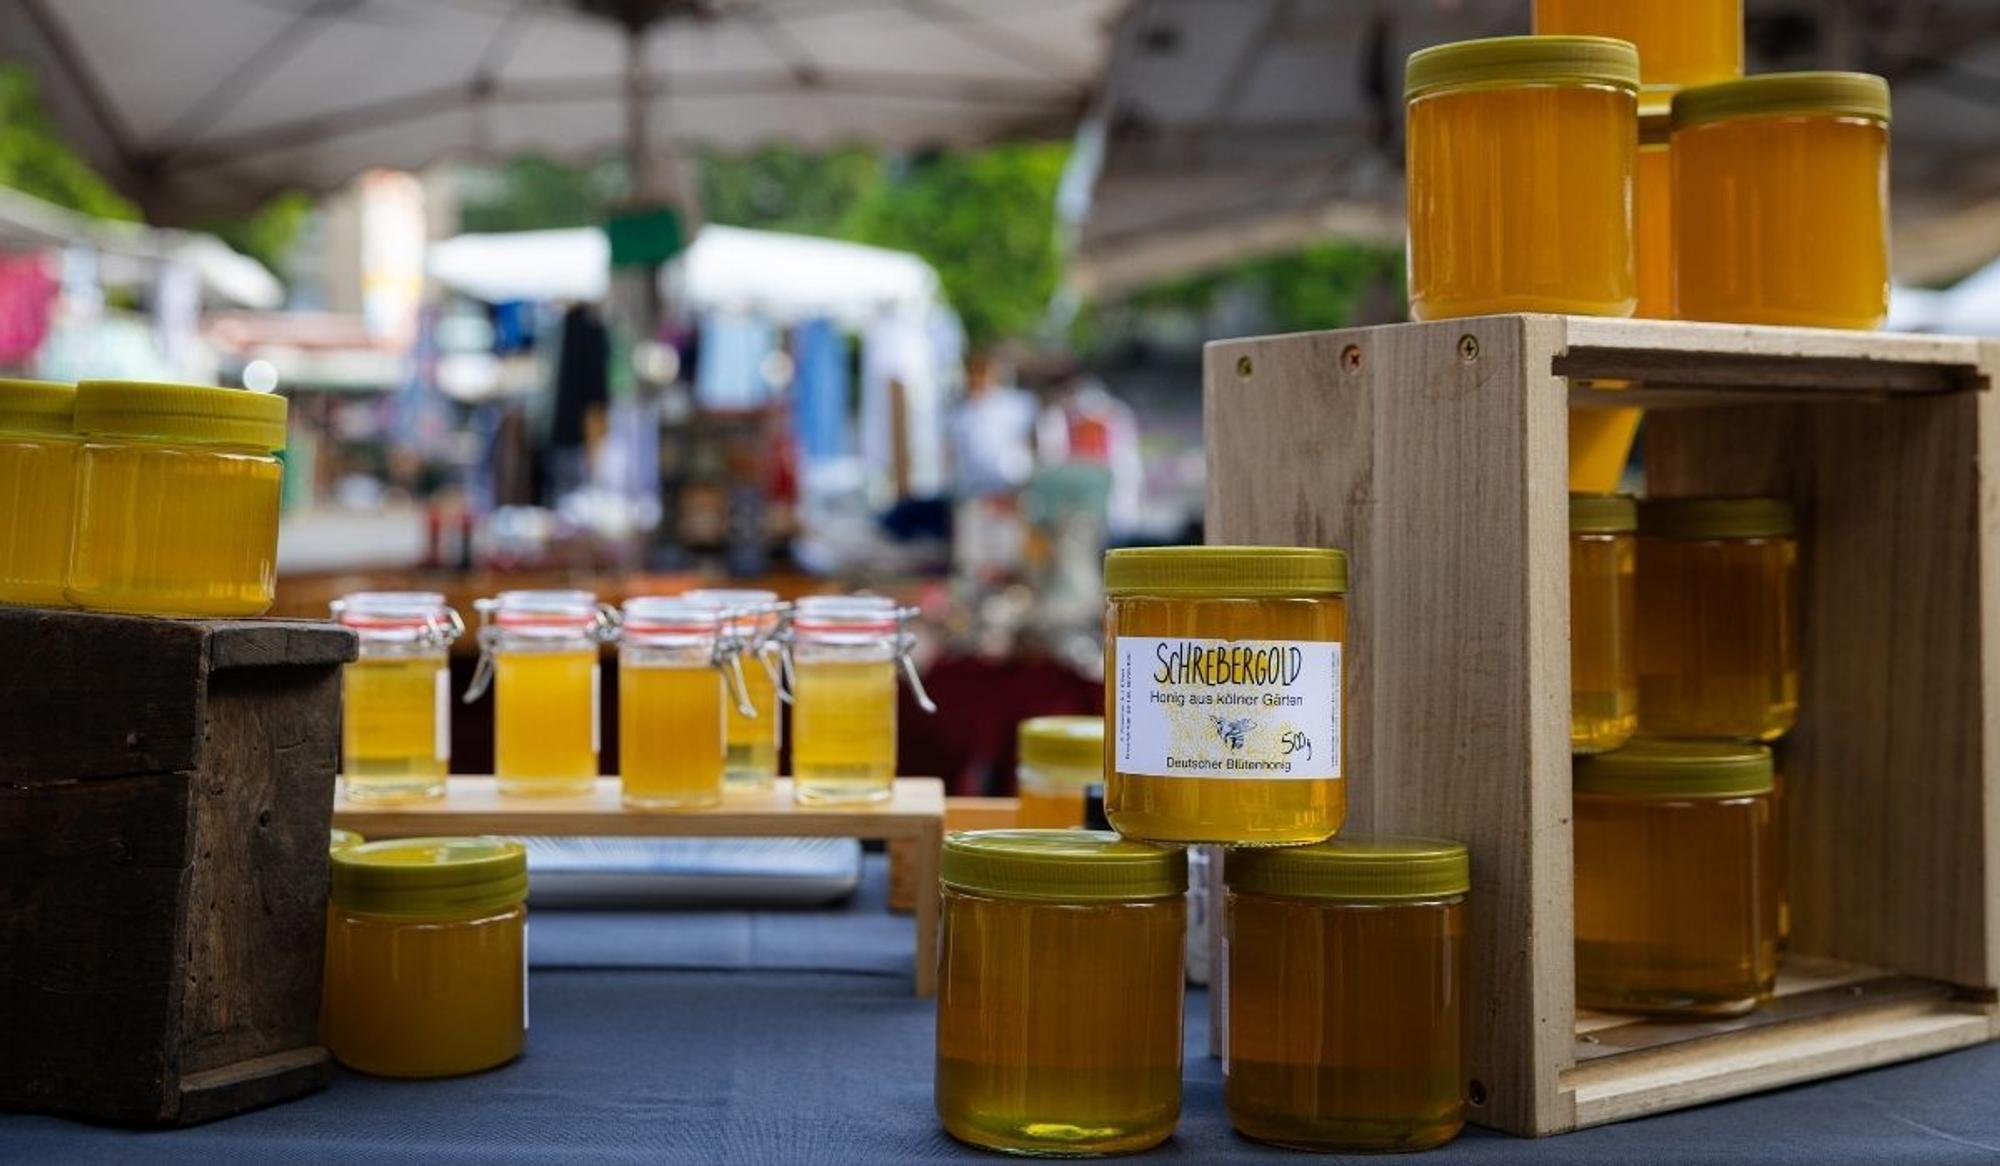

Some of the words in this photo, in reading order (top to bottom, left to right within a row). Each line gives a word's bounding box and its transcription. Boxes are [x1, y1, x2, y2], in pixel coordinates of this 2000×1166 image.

[1150, 690, 1185, 706] Honig
[1189, 693, 1213, 705] aus
[1216, 692, 1258, 705] kölner
[1263, 693, 1304, 706] Gärten
[1281, 731, 1312, 761] 500g
[1166, 756, 1222, 769] Deutscher
[1226, 757, 1292, 772] Blütenhonig
